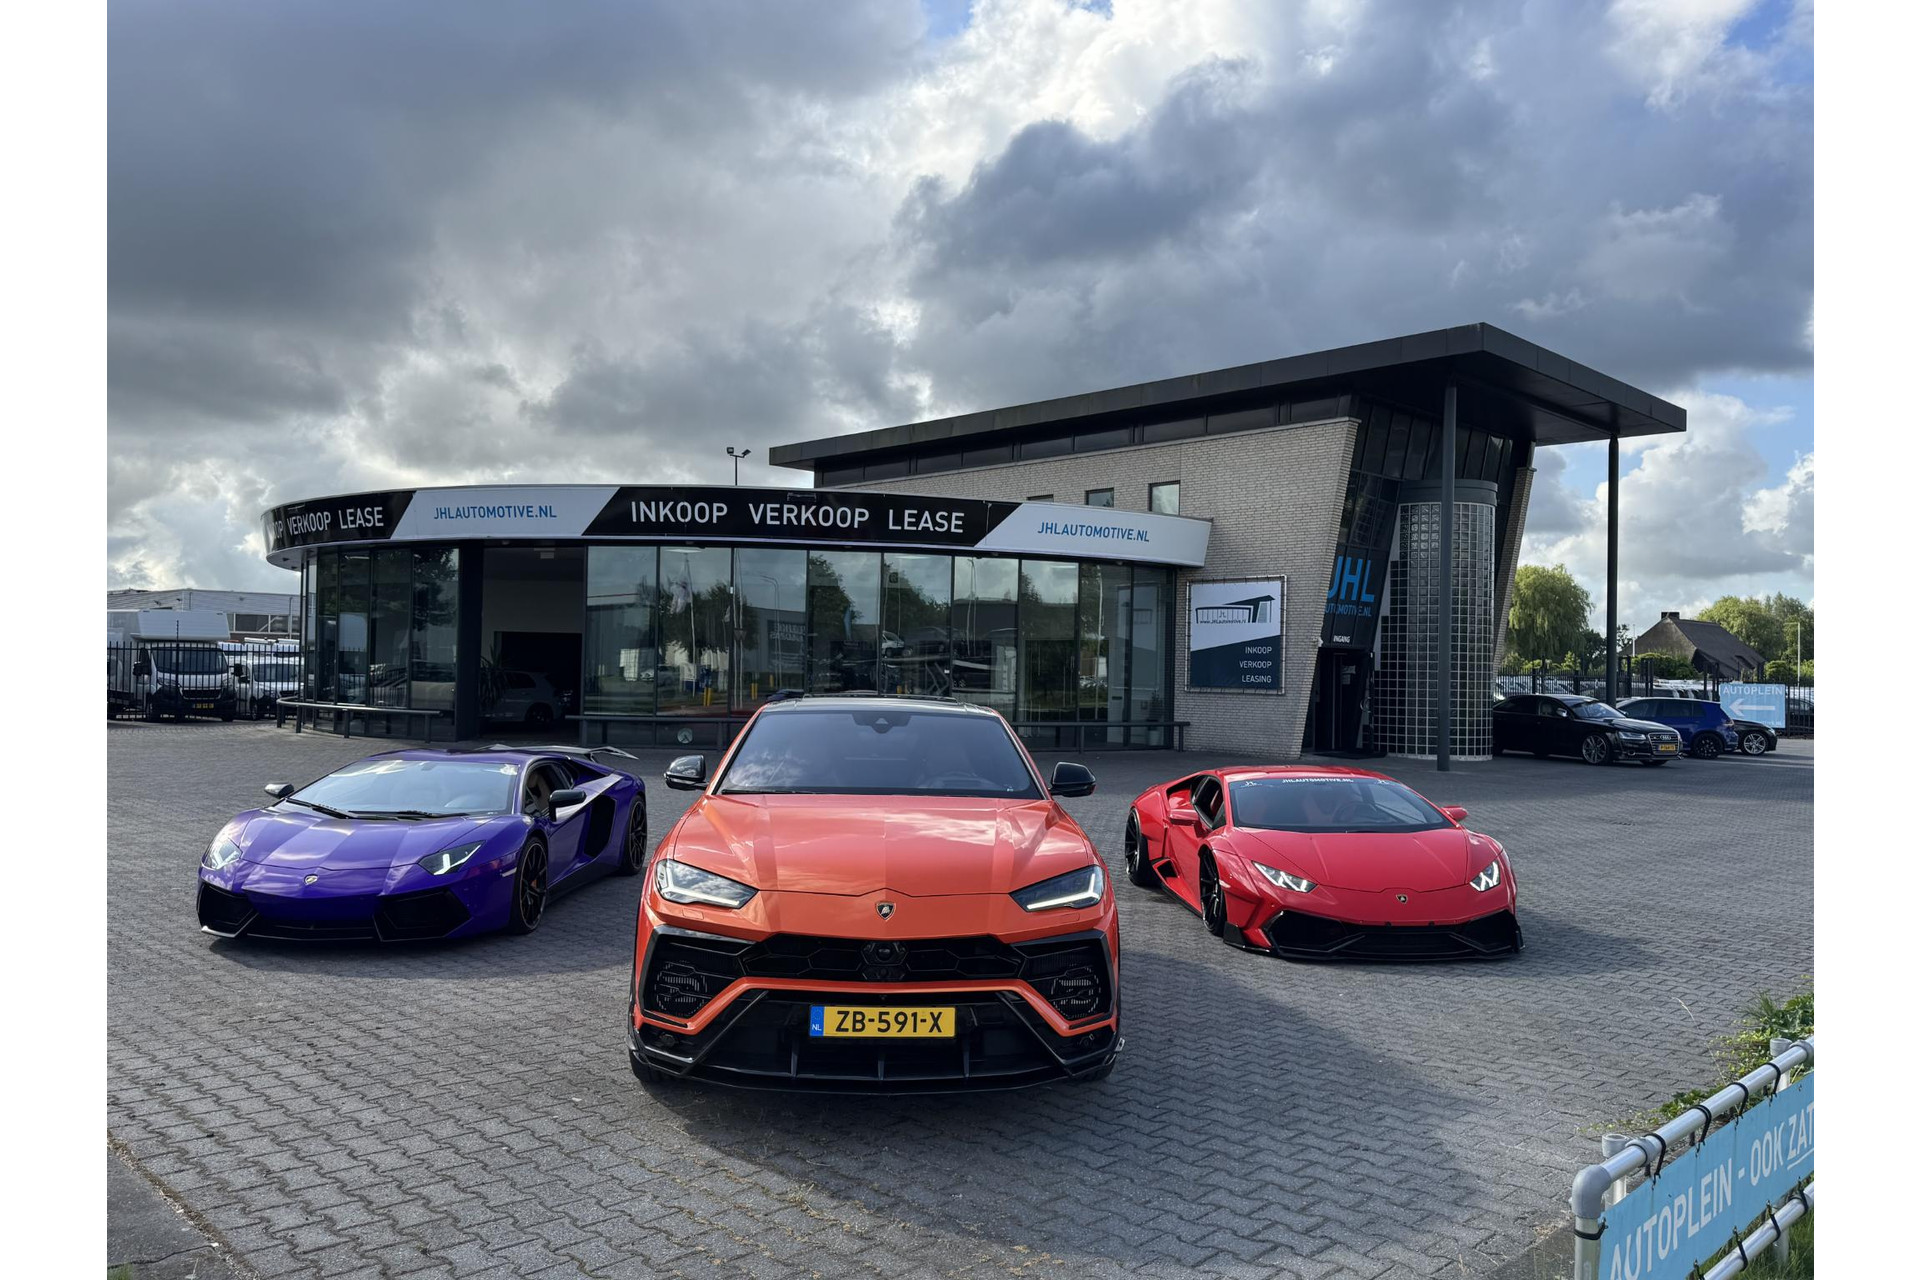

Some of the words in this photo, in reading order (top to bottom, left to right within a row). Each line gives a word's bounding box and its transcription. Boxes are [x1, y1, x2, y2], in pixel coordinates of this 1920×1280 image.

[287, 511, 331, 536] VERKOOP
[338, 506, 384, 530] LEASE
[433, 504, 557, 520] JHLAUTOMOTIVE.NL
[631, 501, 728, 524] INKOOP
[748, 503, 870, 529] VERKOOP
[888, 509, 964, 533] LEASE
[1037, 521, 1150, 543] JHLAUTOMOTIVE.NL
[1327, 556, 1375, 602] JHL
[1325, 603, 1372, 617] UTOMOTIVE.NL
[1245, 646, 1272, 654] INKOOP
[1239, 661, 1272, 669] VERKOOP
[1241, 675, 1272, 684] LEASING
[1722, 686, 1783, 695] AUTOPLEIN
[835, 1010, 943, 1034] ZB-591-X
[1609, 1158, 1732, 1280] AUTOPLEIN
[1750, 1122, 1785, 1187] OOK
